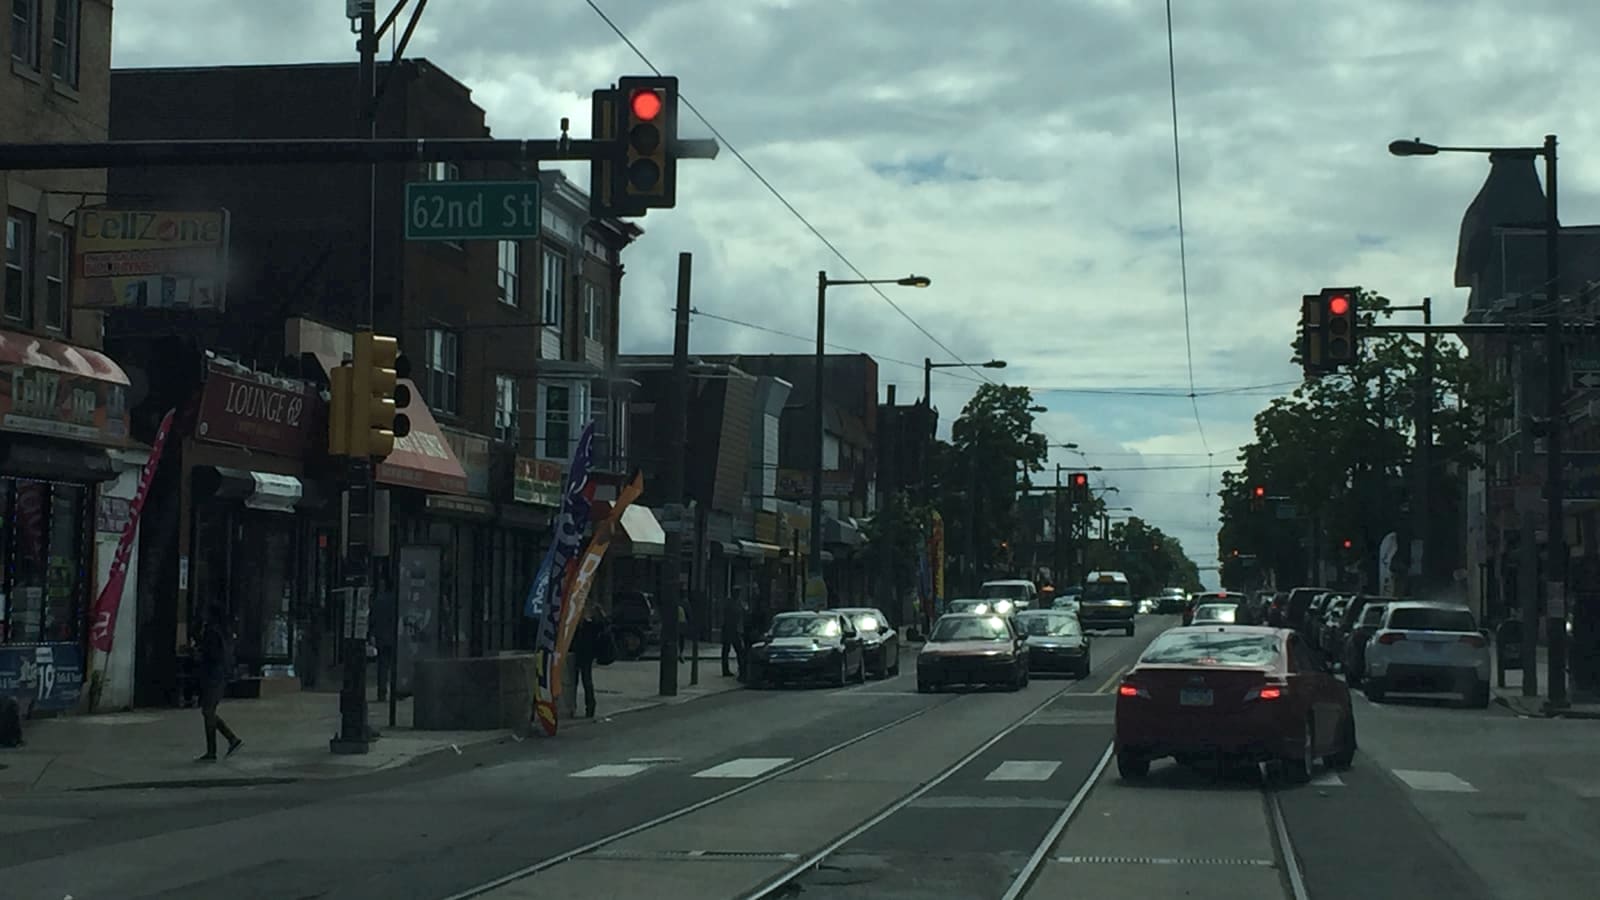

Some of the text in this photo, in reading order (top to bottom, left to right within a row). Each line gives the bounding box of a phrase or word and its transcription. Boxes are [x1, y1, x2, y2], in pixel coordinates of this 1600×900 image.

[412, 192, 534, 229] 62nd St
[224, 381, 304, 428] LOUNGE 62
